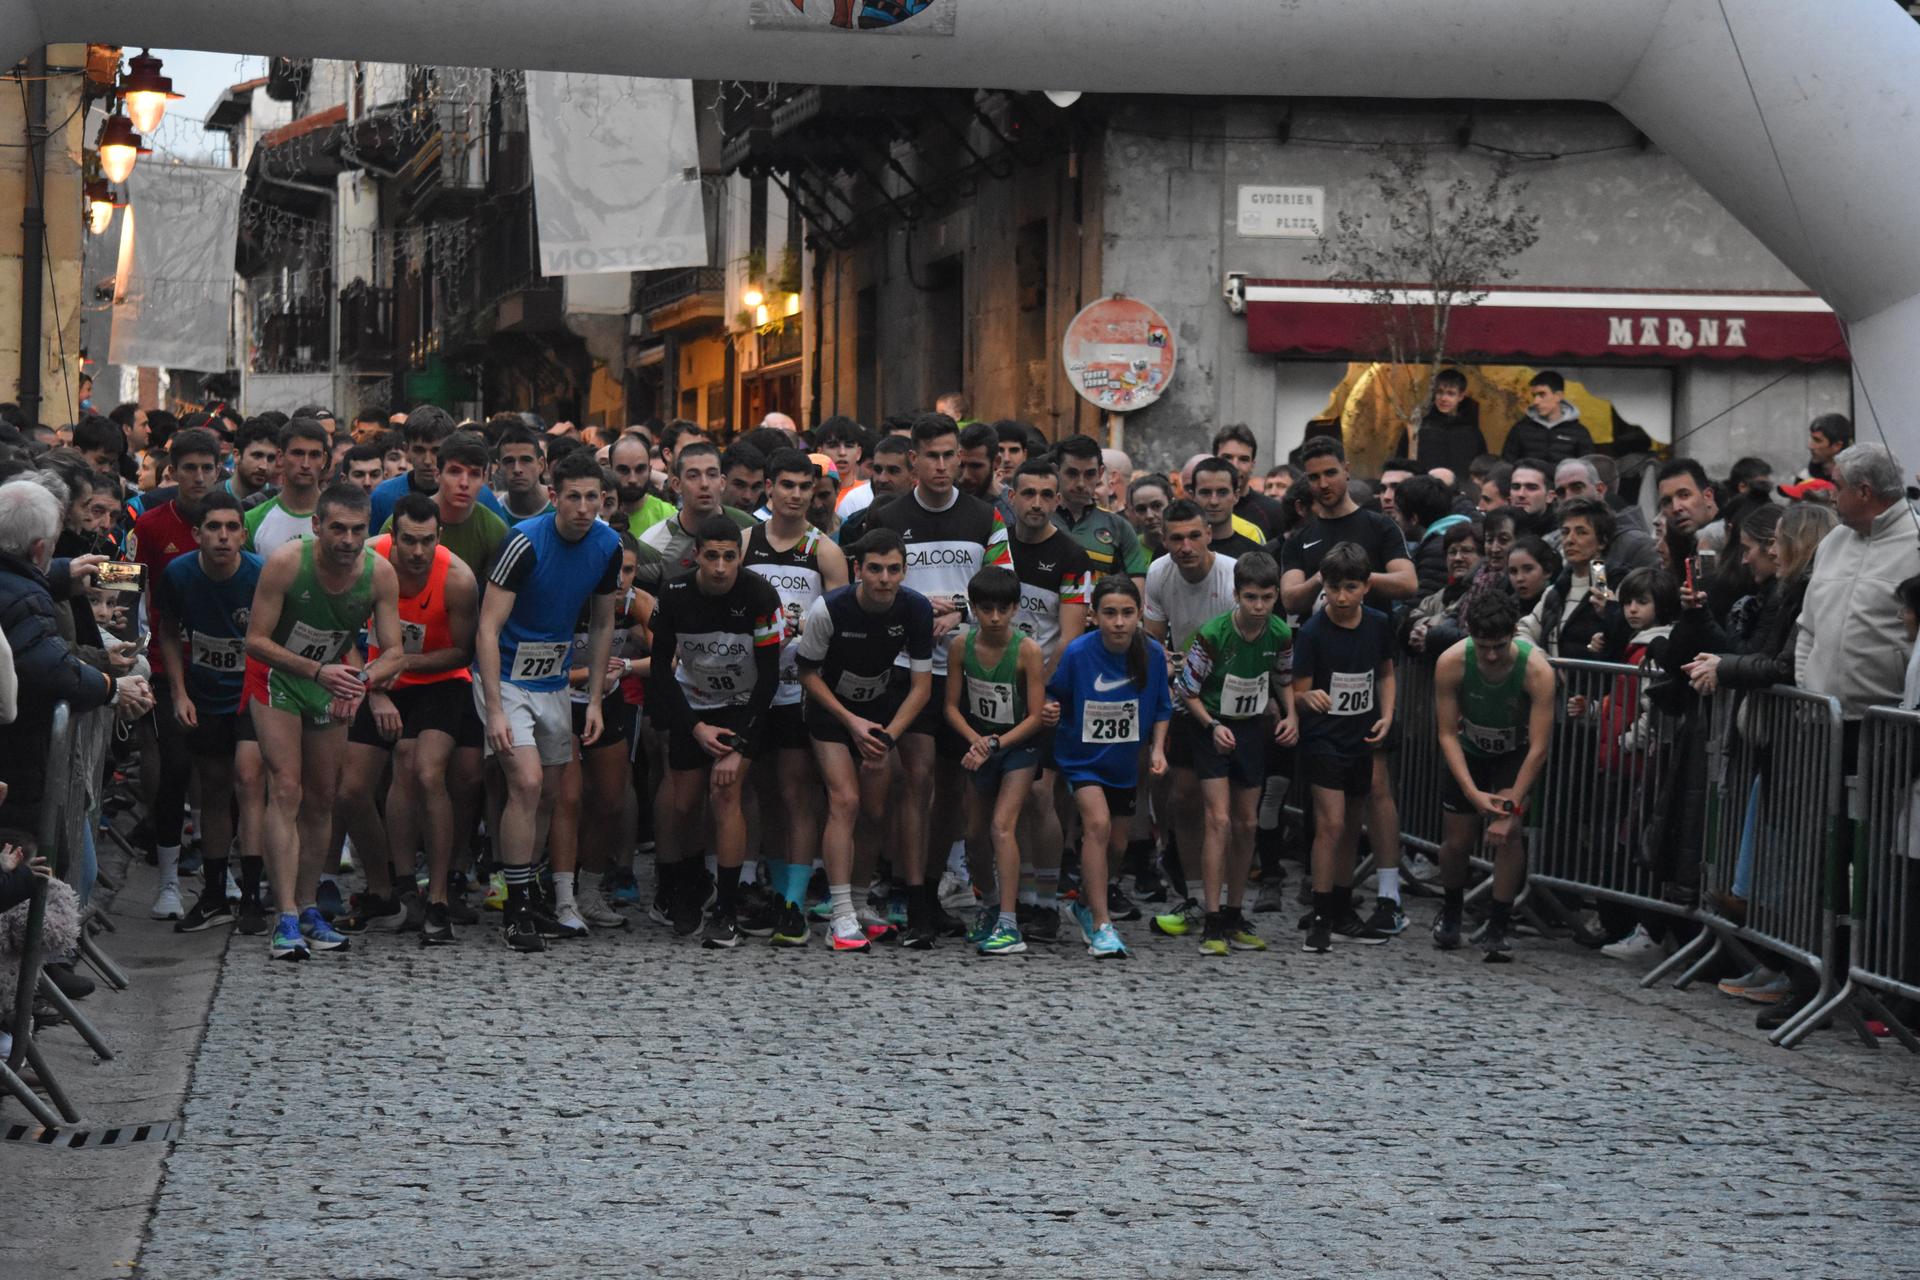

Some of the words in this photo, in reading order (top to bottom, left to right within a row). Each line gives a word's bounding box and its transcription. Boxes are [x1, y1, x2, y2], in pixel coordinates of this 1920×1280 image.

[1607, 315, 1748, 350] MARNA
[904, 548, 973, 567] CALCOSA
[762, 573, 811, 591] COSA
[199, 647, 237, 668] 288
[300, 644, 328, 662] 48
[683, 640, 749, 657] CALCOSA
[520, 657, 556, 677] 273
[706, 675, 736, 691] 38
[852, 687, 876, 701] 31
[1235, 693, 1259, 714] 111
[1337, 689, 1370, 712] 203
[978, 697, 998, 719] 67
[1091, 718, 1130, 739] 238
